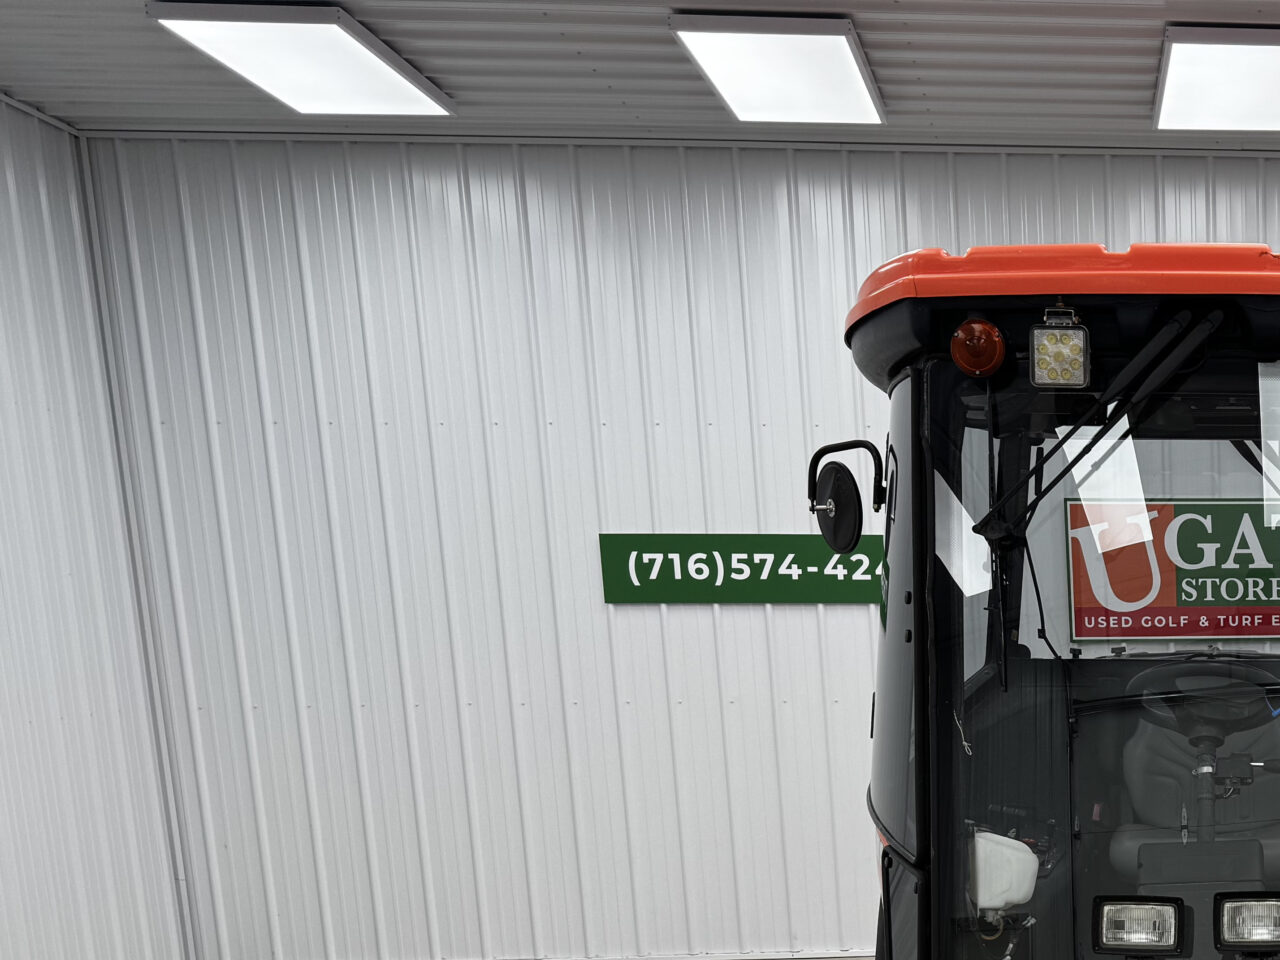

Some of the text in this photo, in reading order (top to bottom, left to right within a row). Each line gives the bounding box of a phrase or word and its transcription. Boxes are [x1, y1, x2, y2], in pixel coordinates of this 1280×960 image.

[1084, 616, 1133, 628] USED
[1141, 615, 1190, 628] GOLF
[1199, 615, 1209, 627] &
[1217, 615, 1263, 627] TURF
